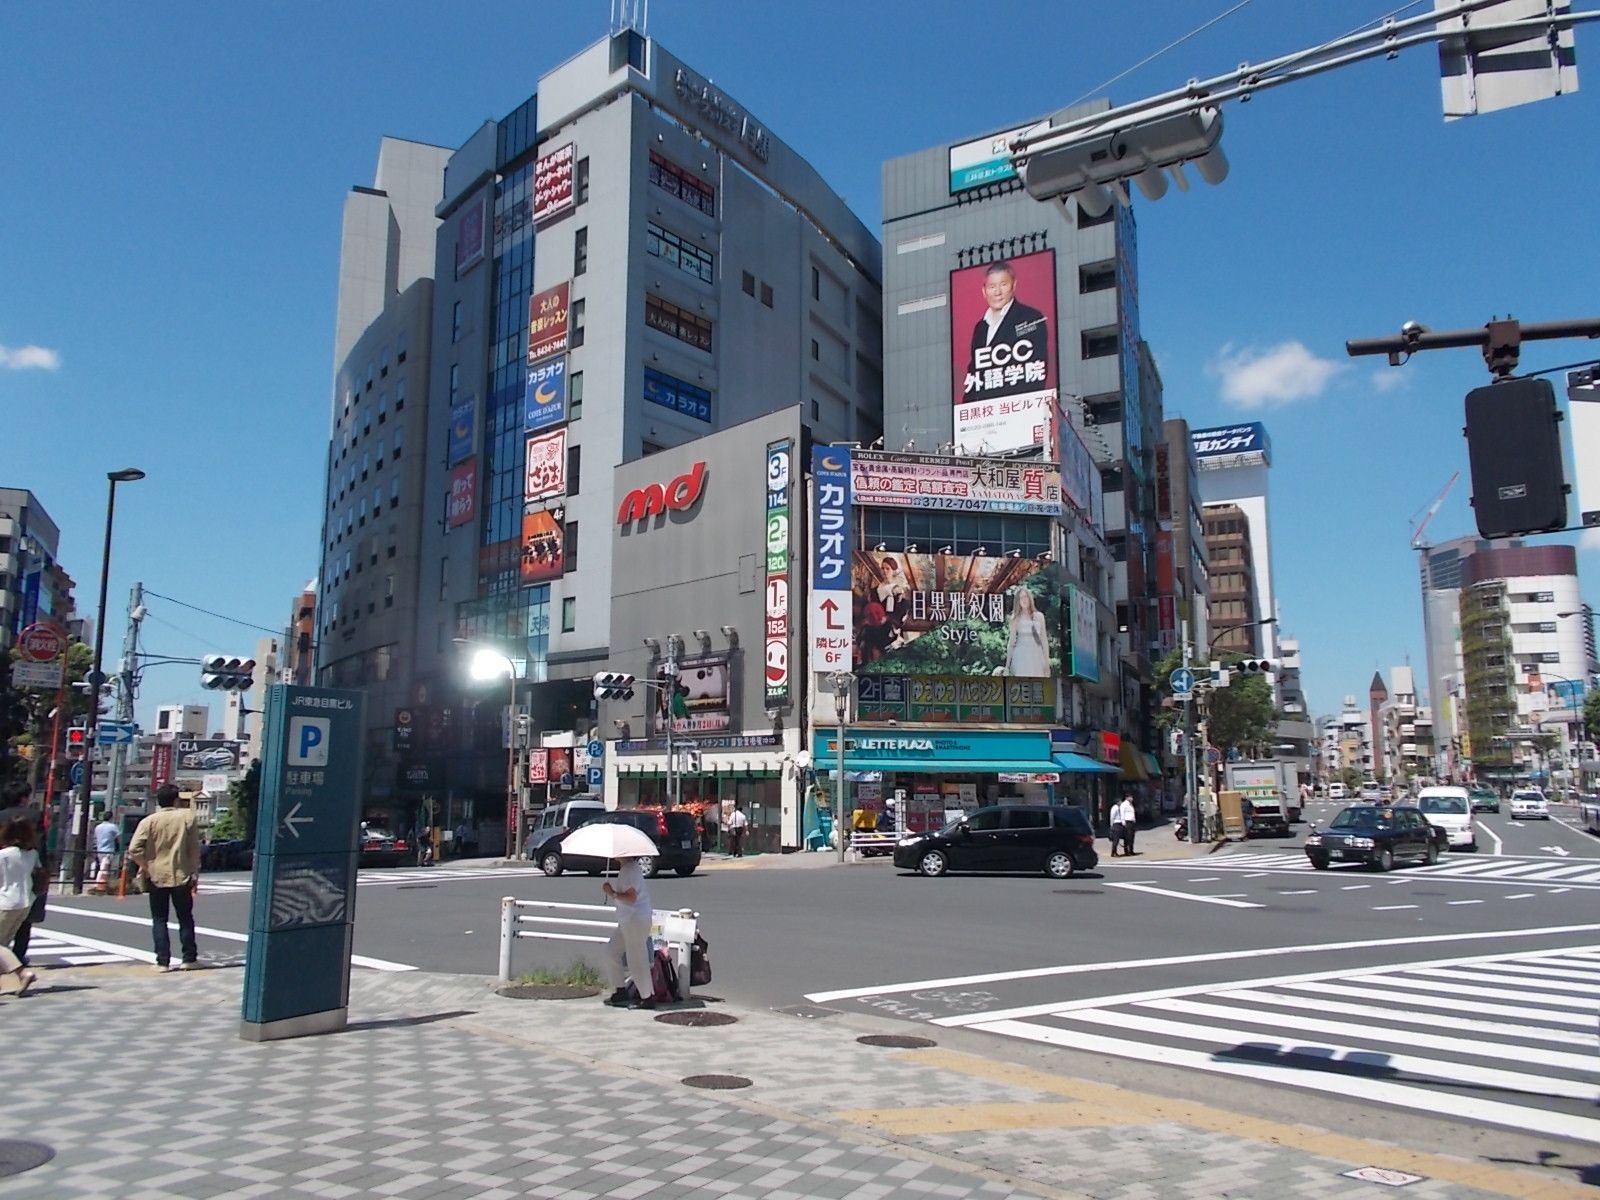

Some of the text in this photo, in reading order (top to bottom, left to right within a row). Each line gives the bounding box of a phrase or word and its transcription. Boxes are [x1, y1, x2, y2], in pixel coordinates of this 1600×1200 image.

[975, 339, 1033, 369] ECC
[528, 361, 565, 385] カラオケ
[964, 360, 1046, 393] 外語学院
[666, 392, 707, 415] カラオケ
[960, 405, 993, 421] 目黒校
[770, 456, 786, 479] 3F
[617, 462, 705, 524] md
[854, 475, 968, 497] 信頼の鑑定 高額査定
[972, 490, 1021, 499] YAMATOYA
[923, 497, 987, 509] 3712-7047
[554, 509, 564, 520] 4F
[769, 519, 786, 543] 2F
[820, 483, 845, 579] カラオケ
[769, 582, 785, 607] 1F
[912, 590, 1004, 622] 目黒雅叙園
[816, 637, 849, 649] 隣ビル
[941, 625, 978, 645] Style
[825, 652, 841, 662] 6F
[860, 677, 880, 698] 2F
[292, 696, 353, 710] JR東急目黒ビル
[180, 741, 198, 752] CLA
[300, 725, 322, 758] P
[899, 739, 934, 750] PLAZA
[287, 771, 324, 786] 駐車場
[591, 769, 600, 780] P
[285, 788, 312, 796] Parking
